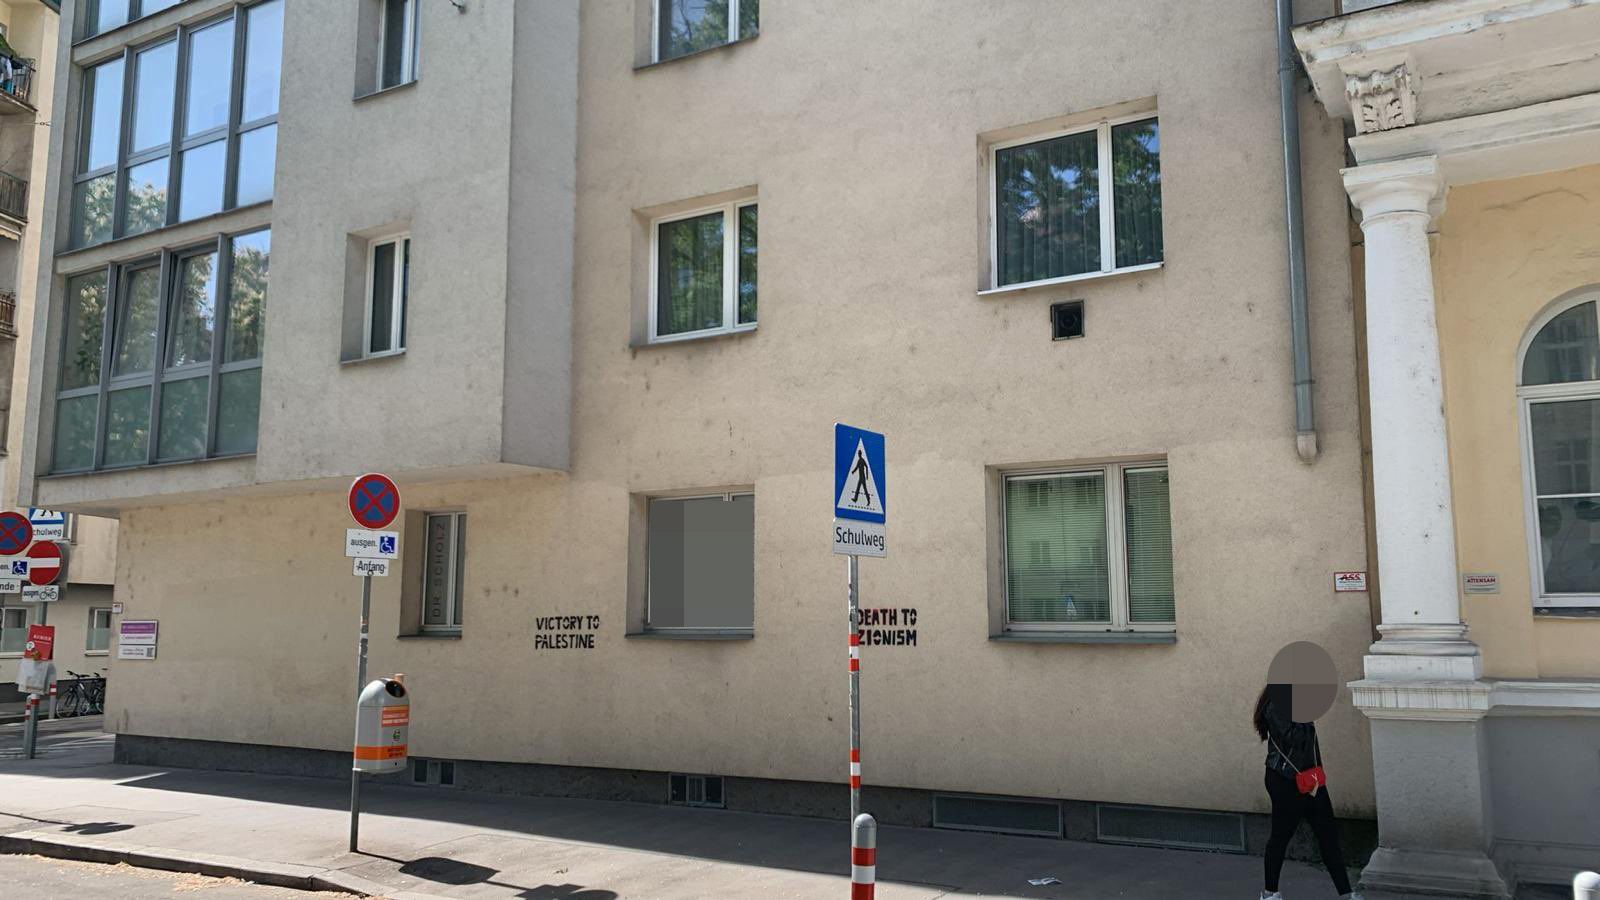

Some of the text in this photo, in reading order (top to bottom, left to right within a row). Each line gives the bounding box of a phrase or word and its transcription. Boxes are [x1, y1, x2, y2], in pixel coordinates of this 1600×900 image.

[33, 528, 62, 537] chulweg
[835, 526, 885, 551] Schulweg
[0, 582, 15, 591] nde
[536, 615, 600, 630] VICTORY TO
[858, 608, 917, 626] DEATH TO
[535, 634, 595, 649] PALESTINE
[858, 629, 917, 647] ZIONISM
